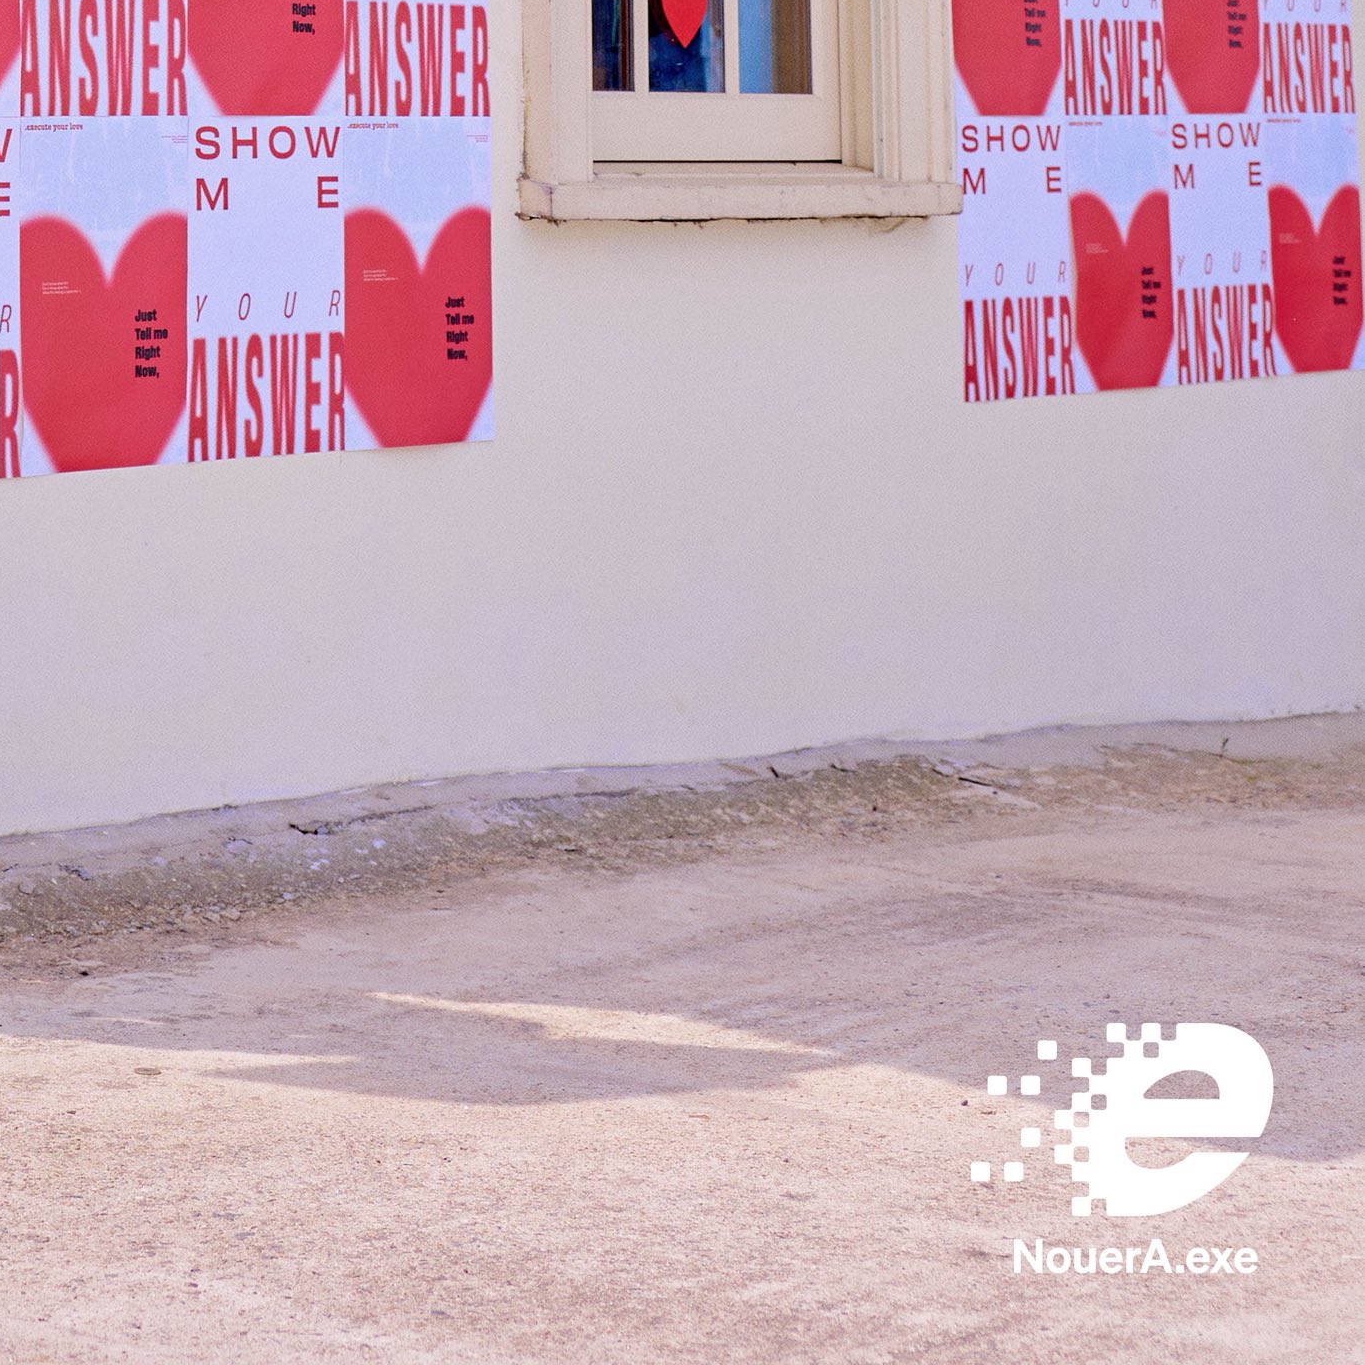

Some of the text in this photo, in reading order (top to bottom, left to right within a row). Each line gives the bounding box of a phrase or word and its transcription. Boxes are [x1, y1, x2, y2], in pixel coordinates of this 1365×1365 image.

[292, 3, 315, 17] Right
[345, 0, 490, 116] ANSWER
[1064, 18, 1167, 115] ANSWER
[1263, 23, 1354, 113] ANSWER
[53, 124, 68, 133] your
[69, 122, 83, 130] love
[195, 125, 341, 160] SHOW
[961, 124, 1060, 152] SHOW
[1171, 122, 1260, 150] SHOW
[135, 310, 156, 322] Just
[135, 328, 168, 340] Tell me
[964, 295, 1074, 402] ANSWER
[1177, 283, 1275, 385] ANSWER
[135, 346, 160, 360] Right
[188, 331, 344, 463] ANSWER
